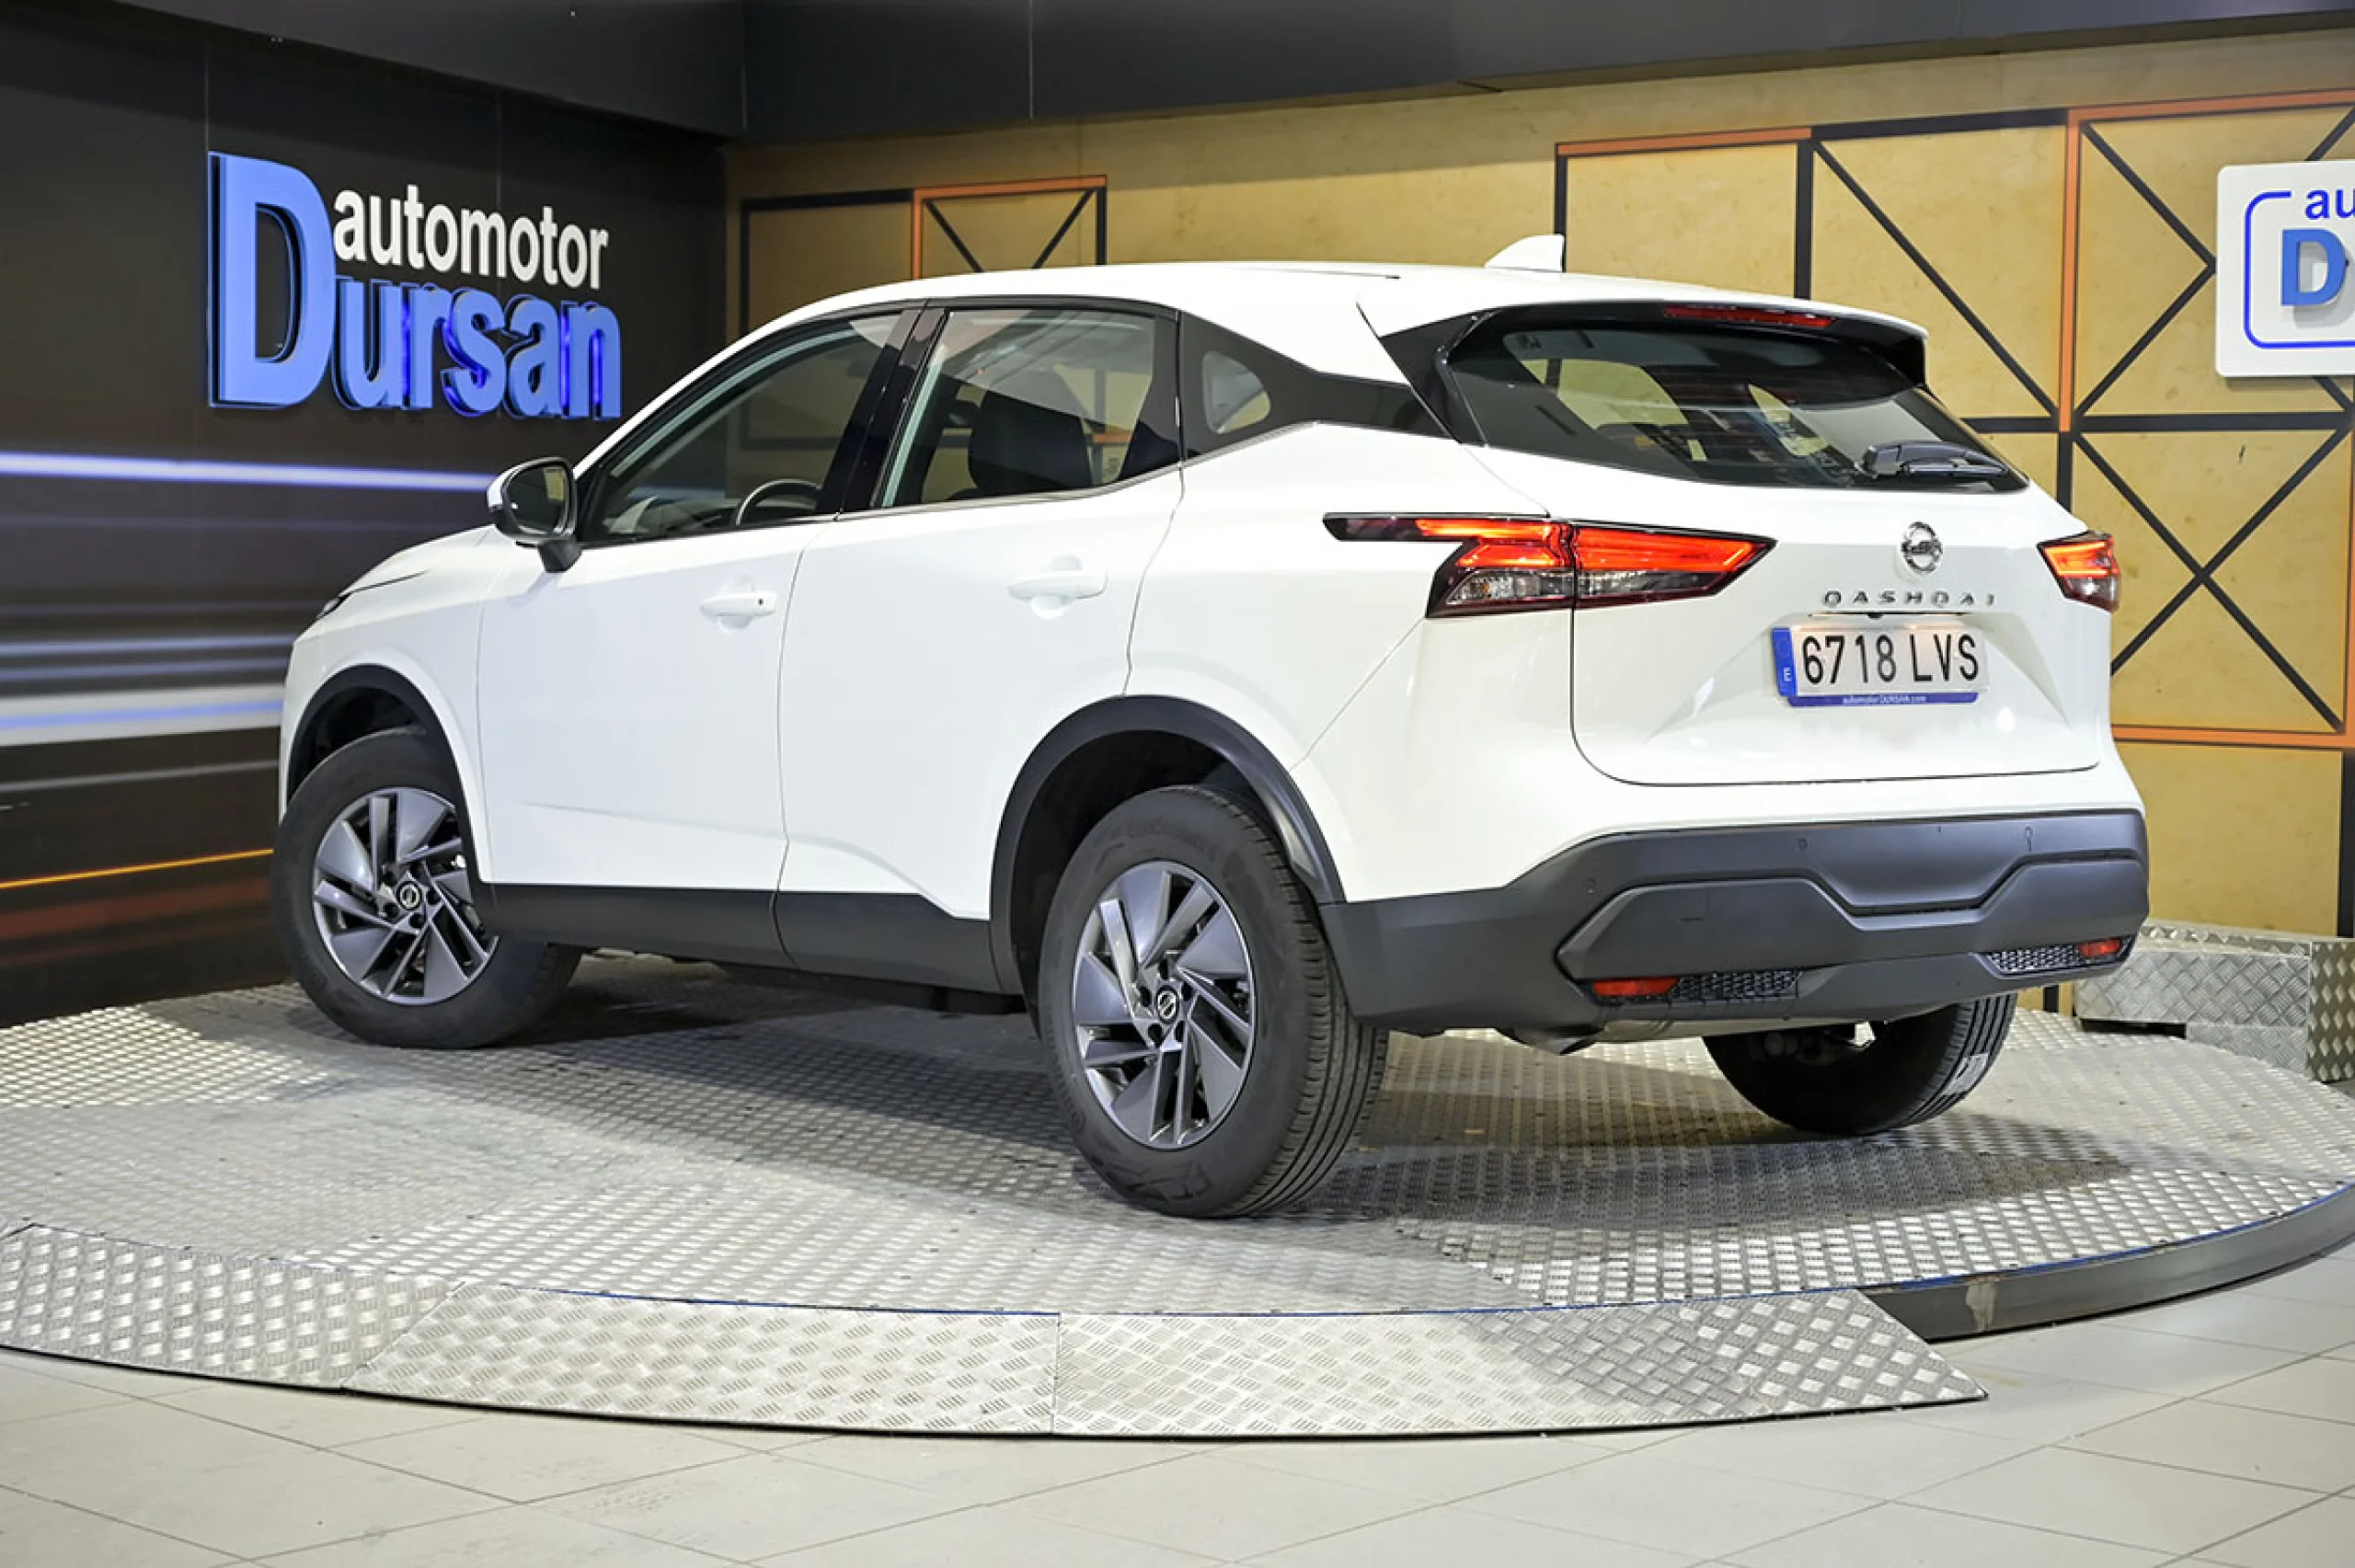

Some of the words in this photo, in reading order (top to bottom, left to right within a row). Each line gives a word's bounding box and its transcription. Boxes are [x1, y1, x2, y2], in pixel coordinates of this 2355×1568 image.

[333, 184, 609, 290] automotor
[207, 151, 621, 419] Dursan
[1822, 589, 1995, 607] QASHQAI
[1801, 635, 1897, 684] 6718
[1909, 634, 1979, 682] LVS
